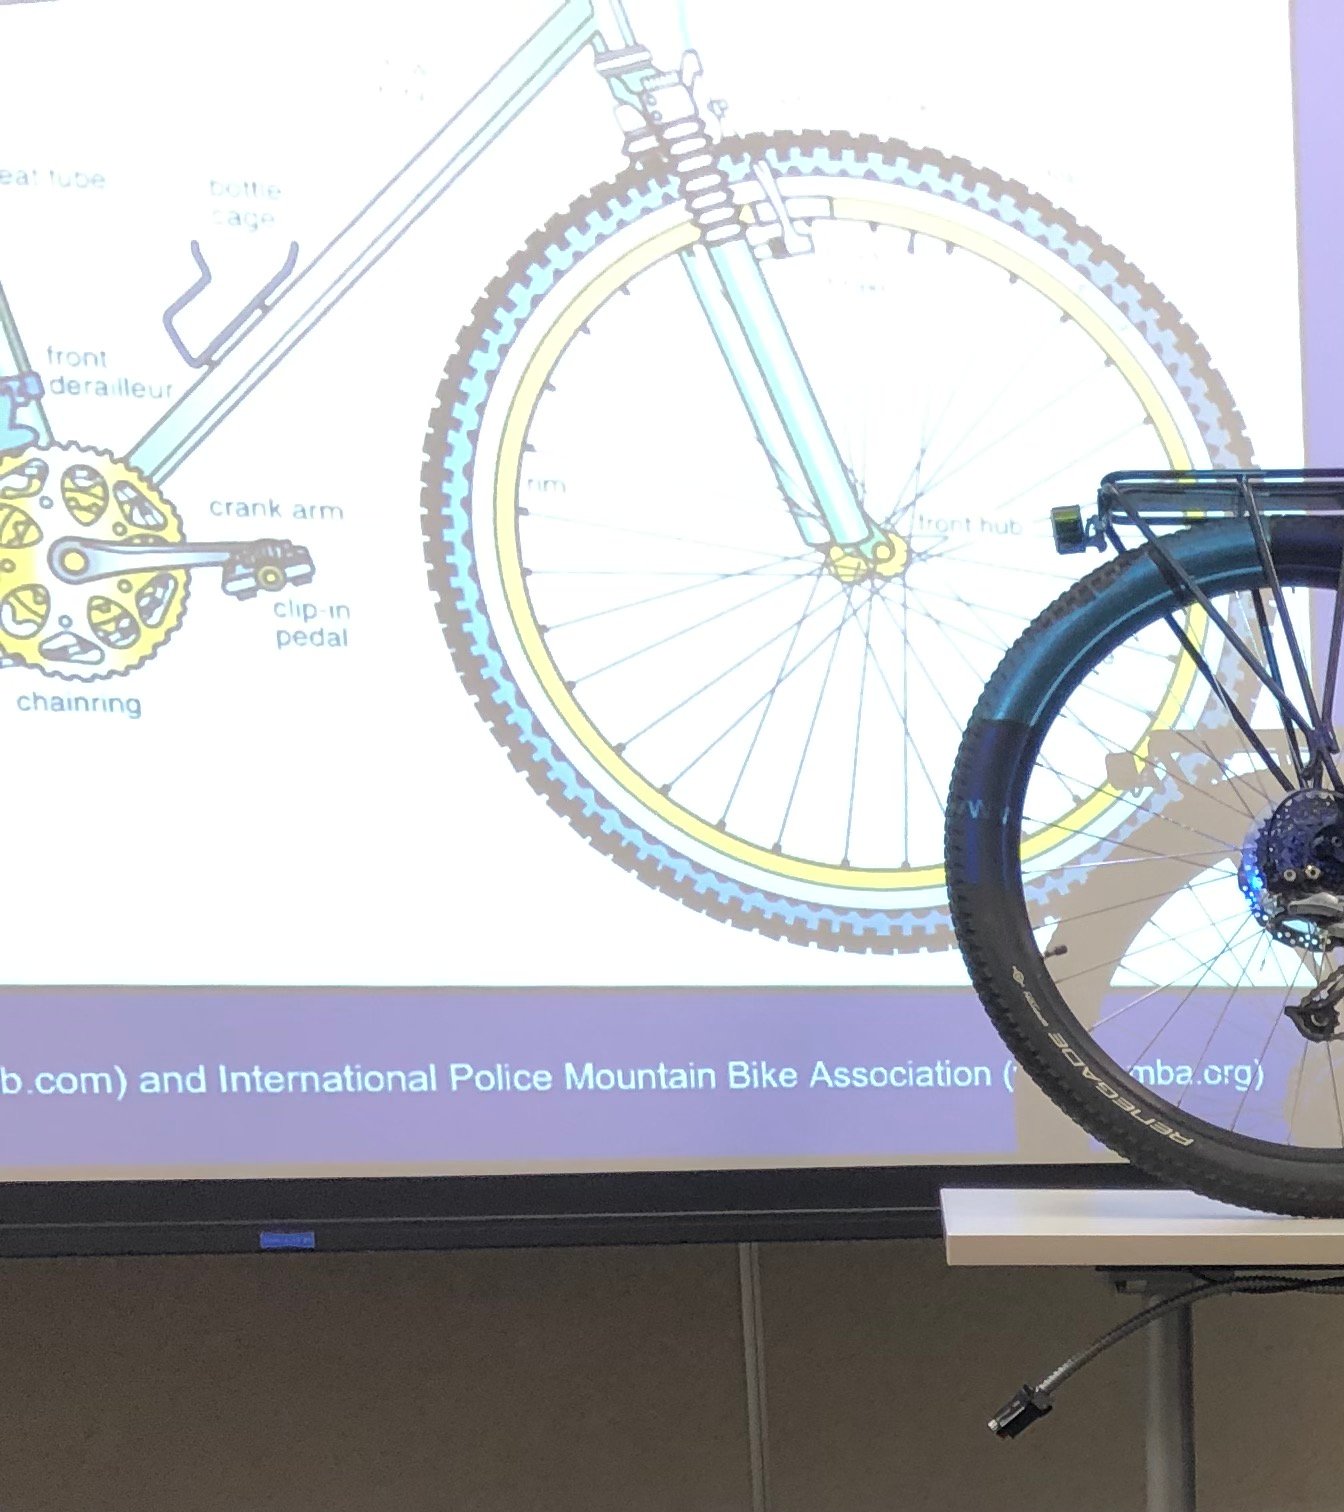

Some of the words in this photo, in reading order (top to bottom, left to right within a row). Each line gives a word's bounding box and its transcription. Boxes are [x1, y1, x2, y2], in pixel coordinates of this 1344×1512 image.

[50, 170, 107, 188] tube
[47, 346, 107, 368] front
[50, 376, 173, 399] derailleur
[210, 499, 282, 518] crank
[293, 501, 344, 520] arm
[980, 515, 1022, 535] hub
[274, 599, 350, 620] clip-in
[276, 627, 349, 650] pedal
[17, 691, 142, 719] chainring
[139, 1064, 207, 1094] and
[218, 1063, 438, 1094] International
[449, 1062, 553, 1092] Police
[565, 1061, 714, 1091] Mountain
[729, 1060, 800, 1089] Bike
[809, 1059, 992, 1089] Association
